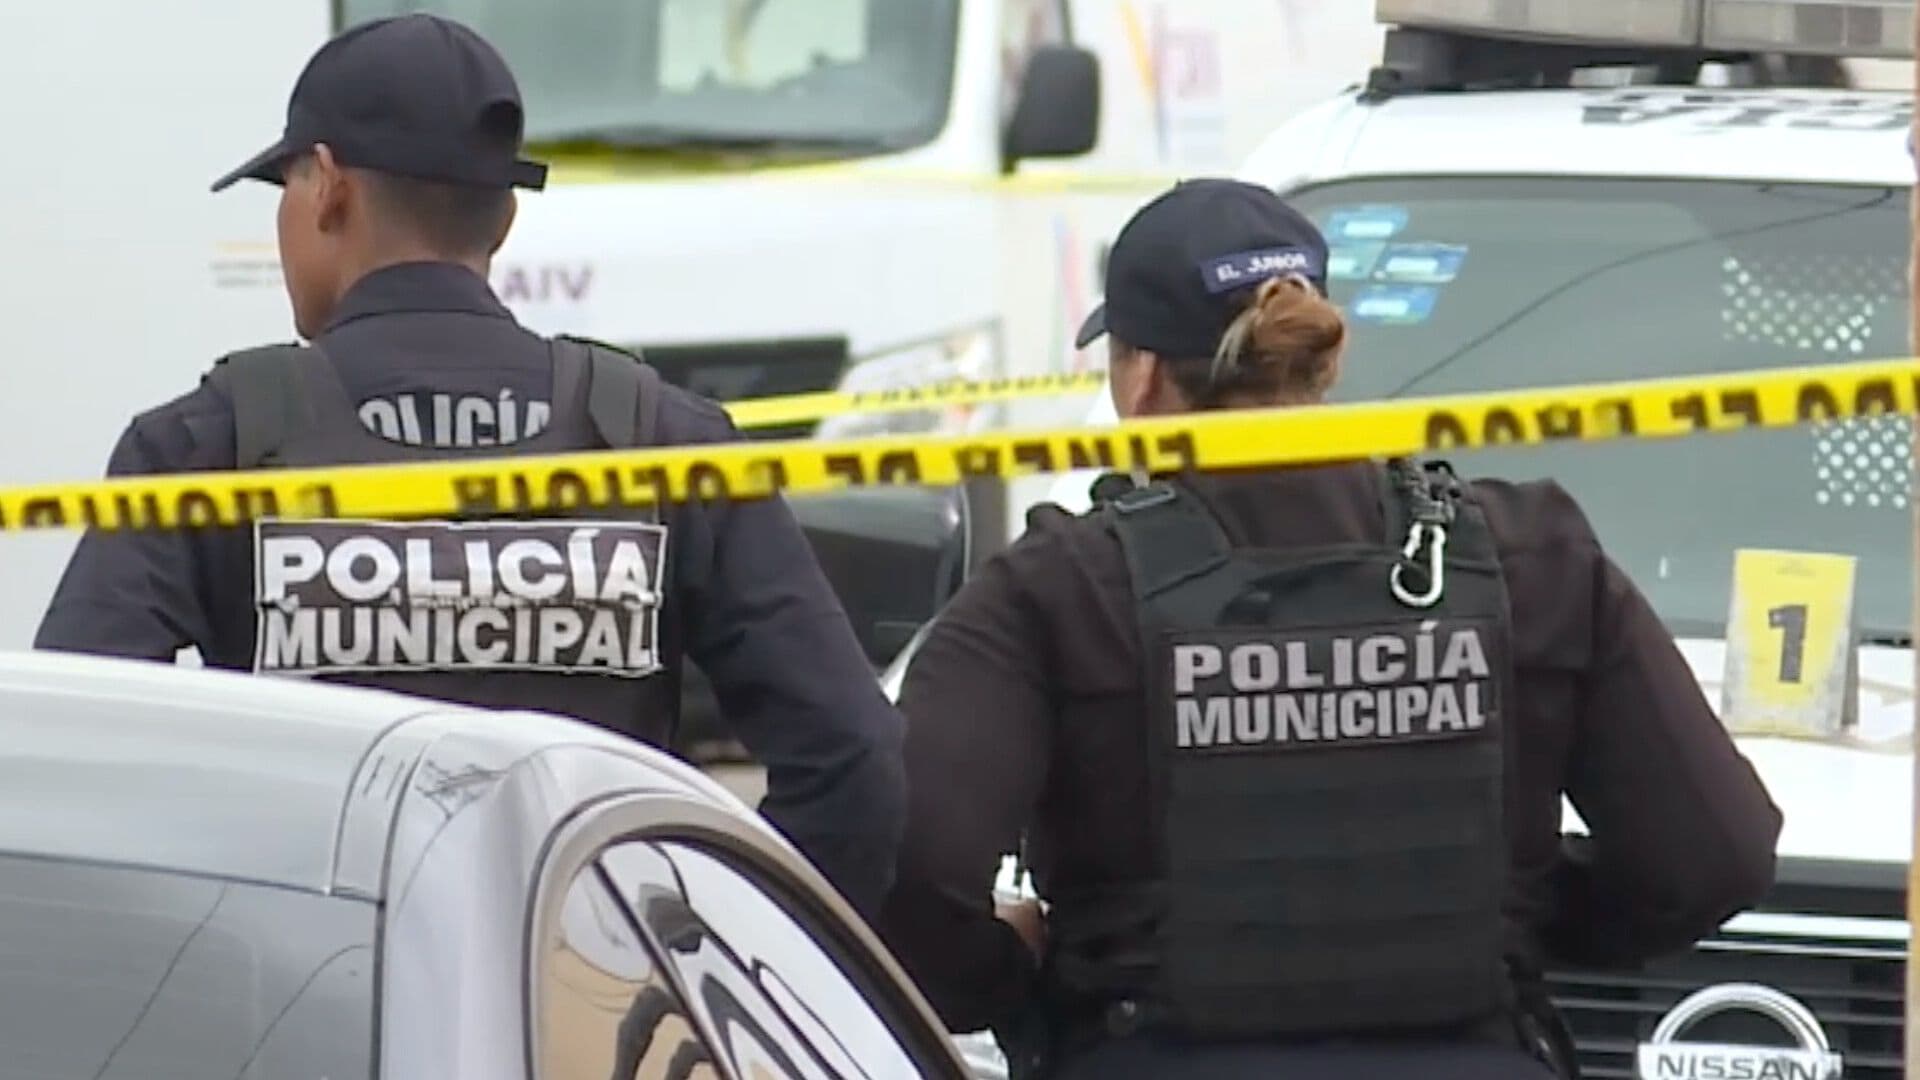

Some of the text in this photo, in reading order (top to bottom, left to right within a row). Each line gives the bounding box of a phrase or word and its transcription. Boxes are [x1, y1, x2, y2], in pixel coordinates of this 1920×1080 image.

[357, 388, 549, 447] OLICÍA
[262, 529, 656, 602] POLICÍA
[263, 605, 655, 668] MUNICIPAL
[1173, 620, 1490, 694] POLICÍA
[1768, 604, 1808, 684] 1
[1176, 683, 1486, 748] MUNICIPAL
[1657, 1053, 1818, 1080] NISSAN
